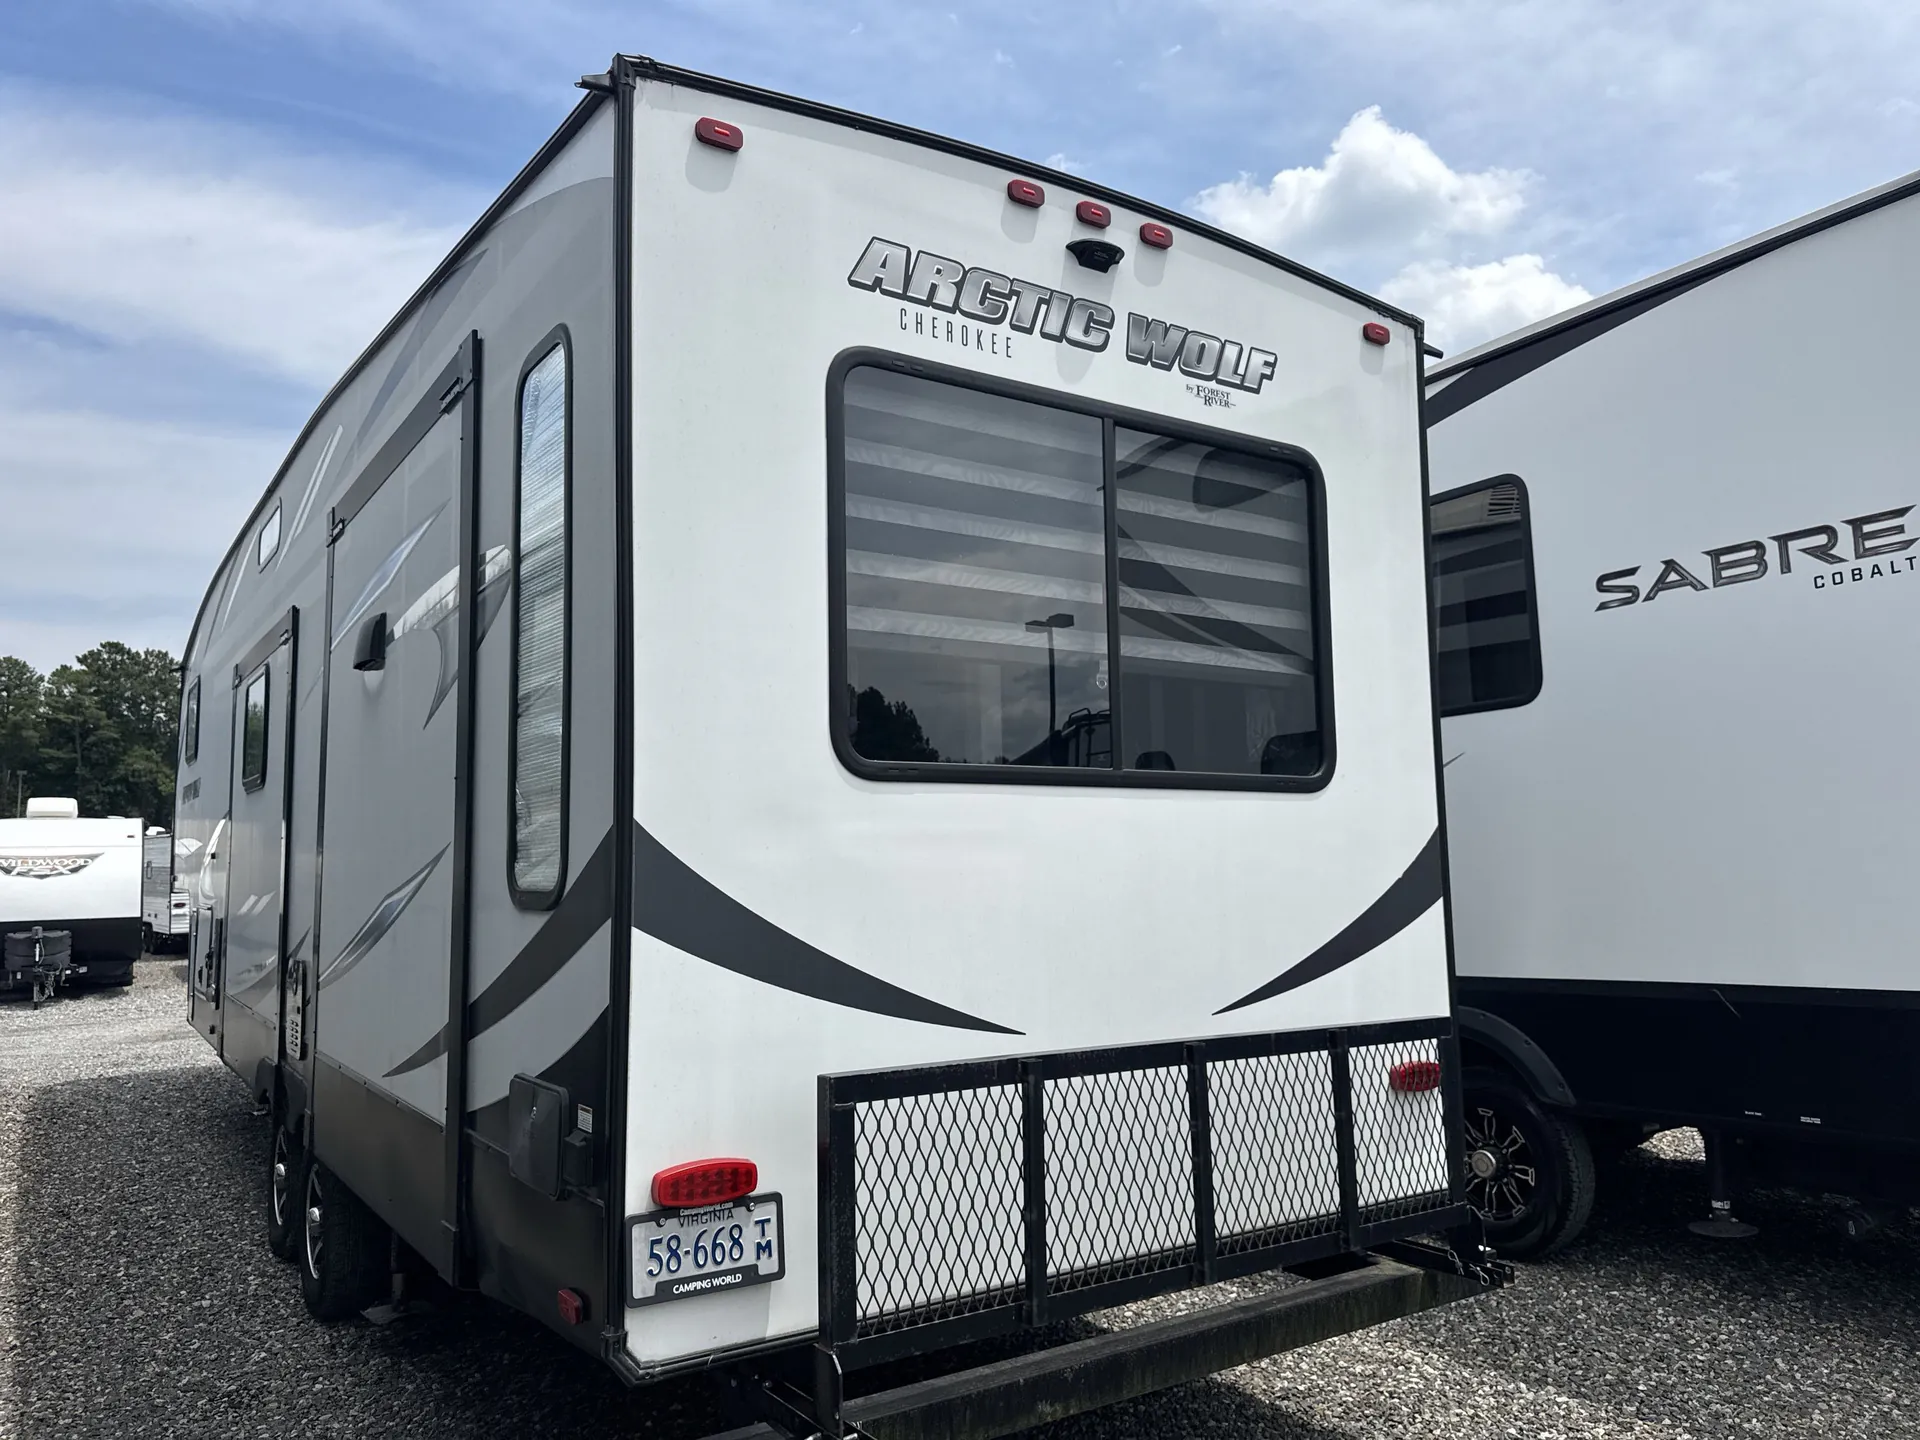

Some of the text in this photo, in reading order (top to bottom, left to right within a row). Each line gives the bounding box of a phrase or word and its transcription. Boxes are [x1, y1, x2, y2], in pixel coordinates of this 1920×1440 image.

[848, 236, 1278, 394] ARCTIC WOLF
[900, 307, 1012, 358] CHEROKEE
[1186, 384, 1231, 400] by FOREST
[1204, 395, 1231, 408] RIVER
[1594, 504, 1920, 612] SABRE
[1813, 556, 1917, 589] COBALT
[678, 1209, 734, 1228] VIRGINIA
[647, 1223, 744, 1277] 58-668
[673, 1273, 743, 1294] CAMPING WORLD
